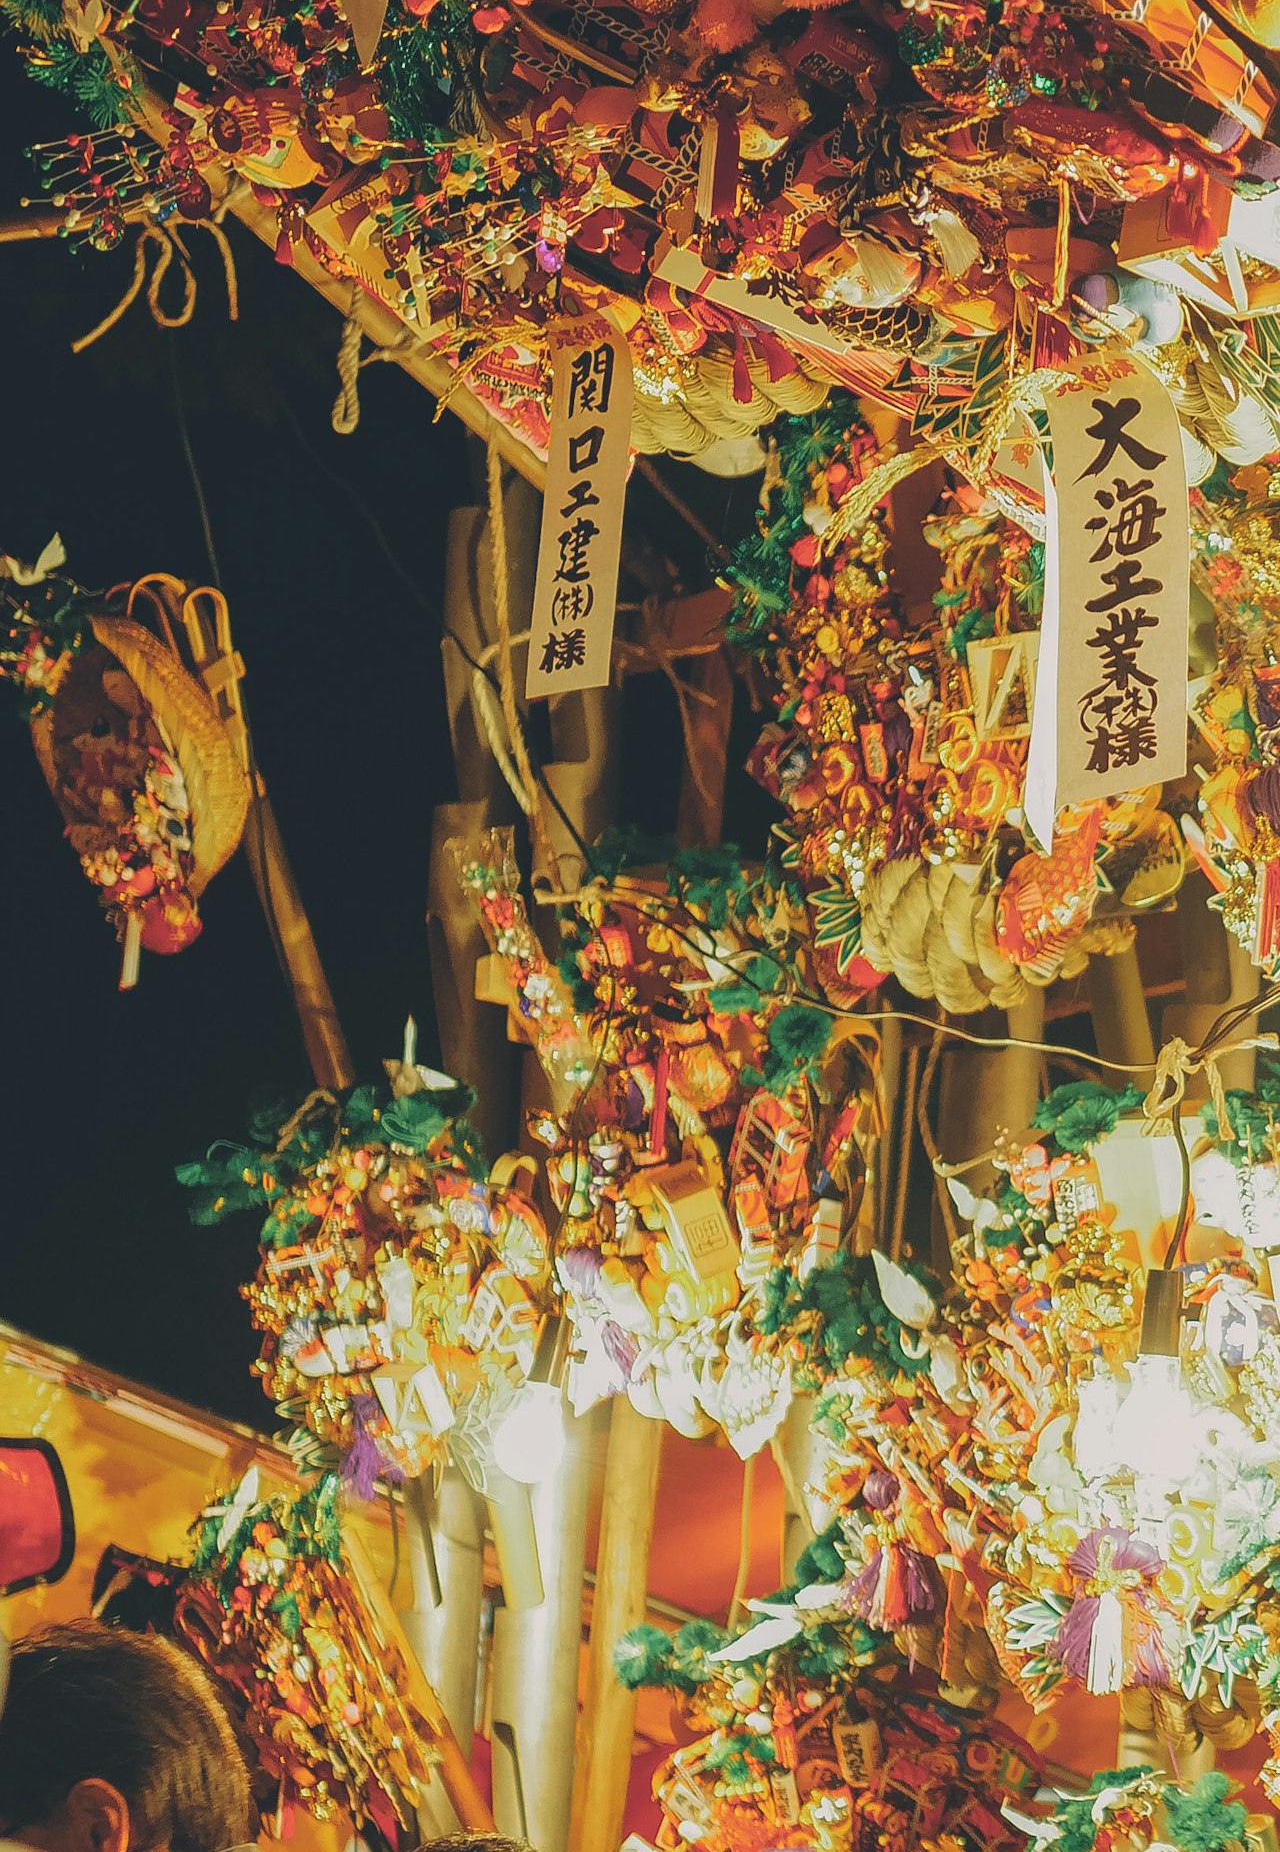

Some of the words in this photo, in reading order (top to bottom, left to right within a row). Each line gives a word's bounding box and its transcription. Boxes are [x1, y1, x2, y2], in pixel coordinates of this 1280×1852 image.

[1074, 393, 1169, 774] 大海工業(株)様
